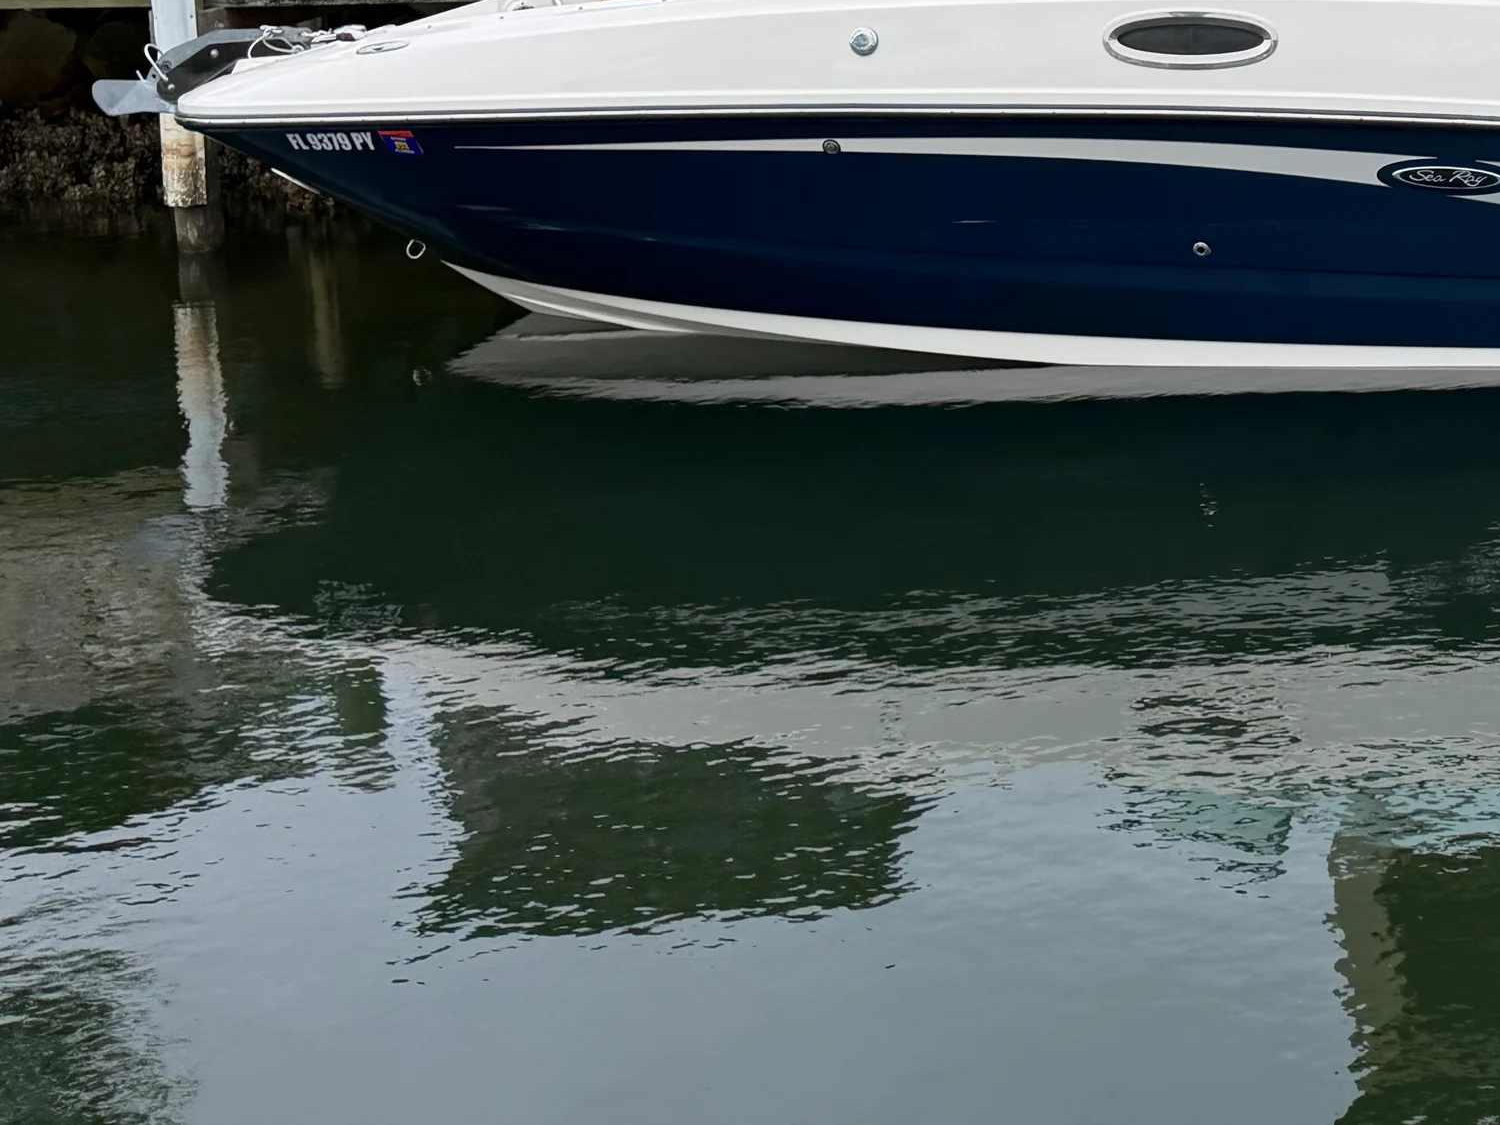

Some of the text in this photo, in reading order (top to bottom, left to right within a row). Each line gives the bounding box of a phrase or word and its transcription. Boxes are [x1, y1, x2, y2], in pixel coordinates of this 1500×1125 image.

[285, 132, 310, 151] FL
[305, 131, 353, 151] 9379
[350, 131, 376, 151] PY
[1408, 169, 1488, 187] Sea Ray
